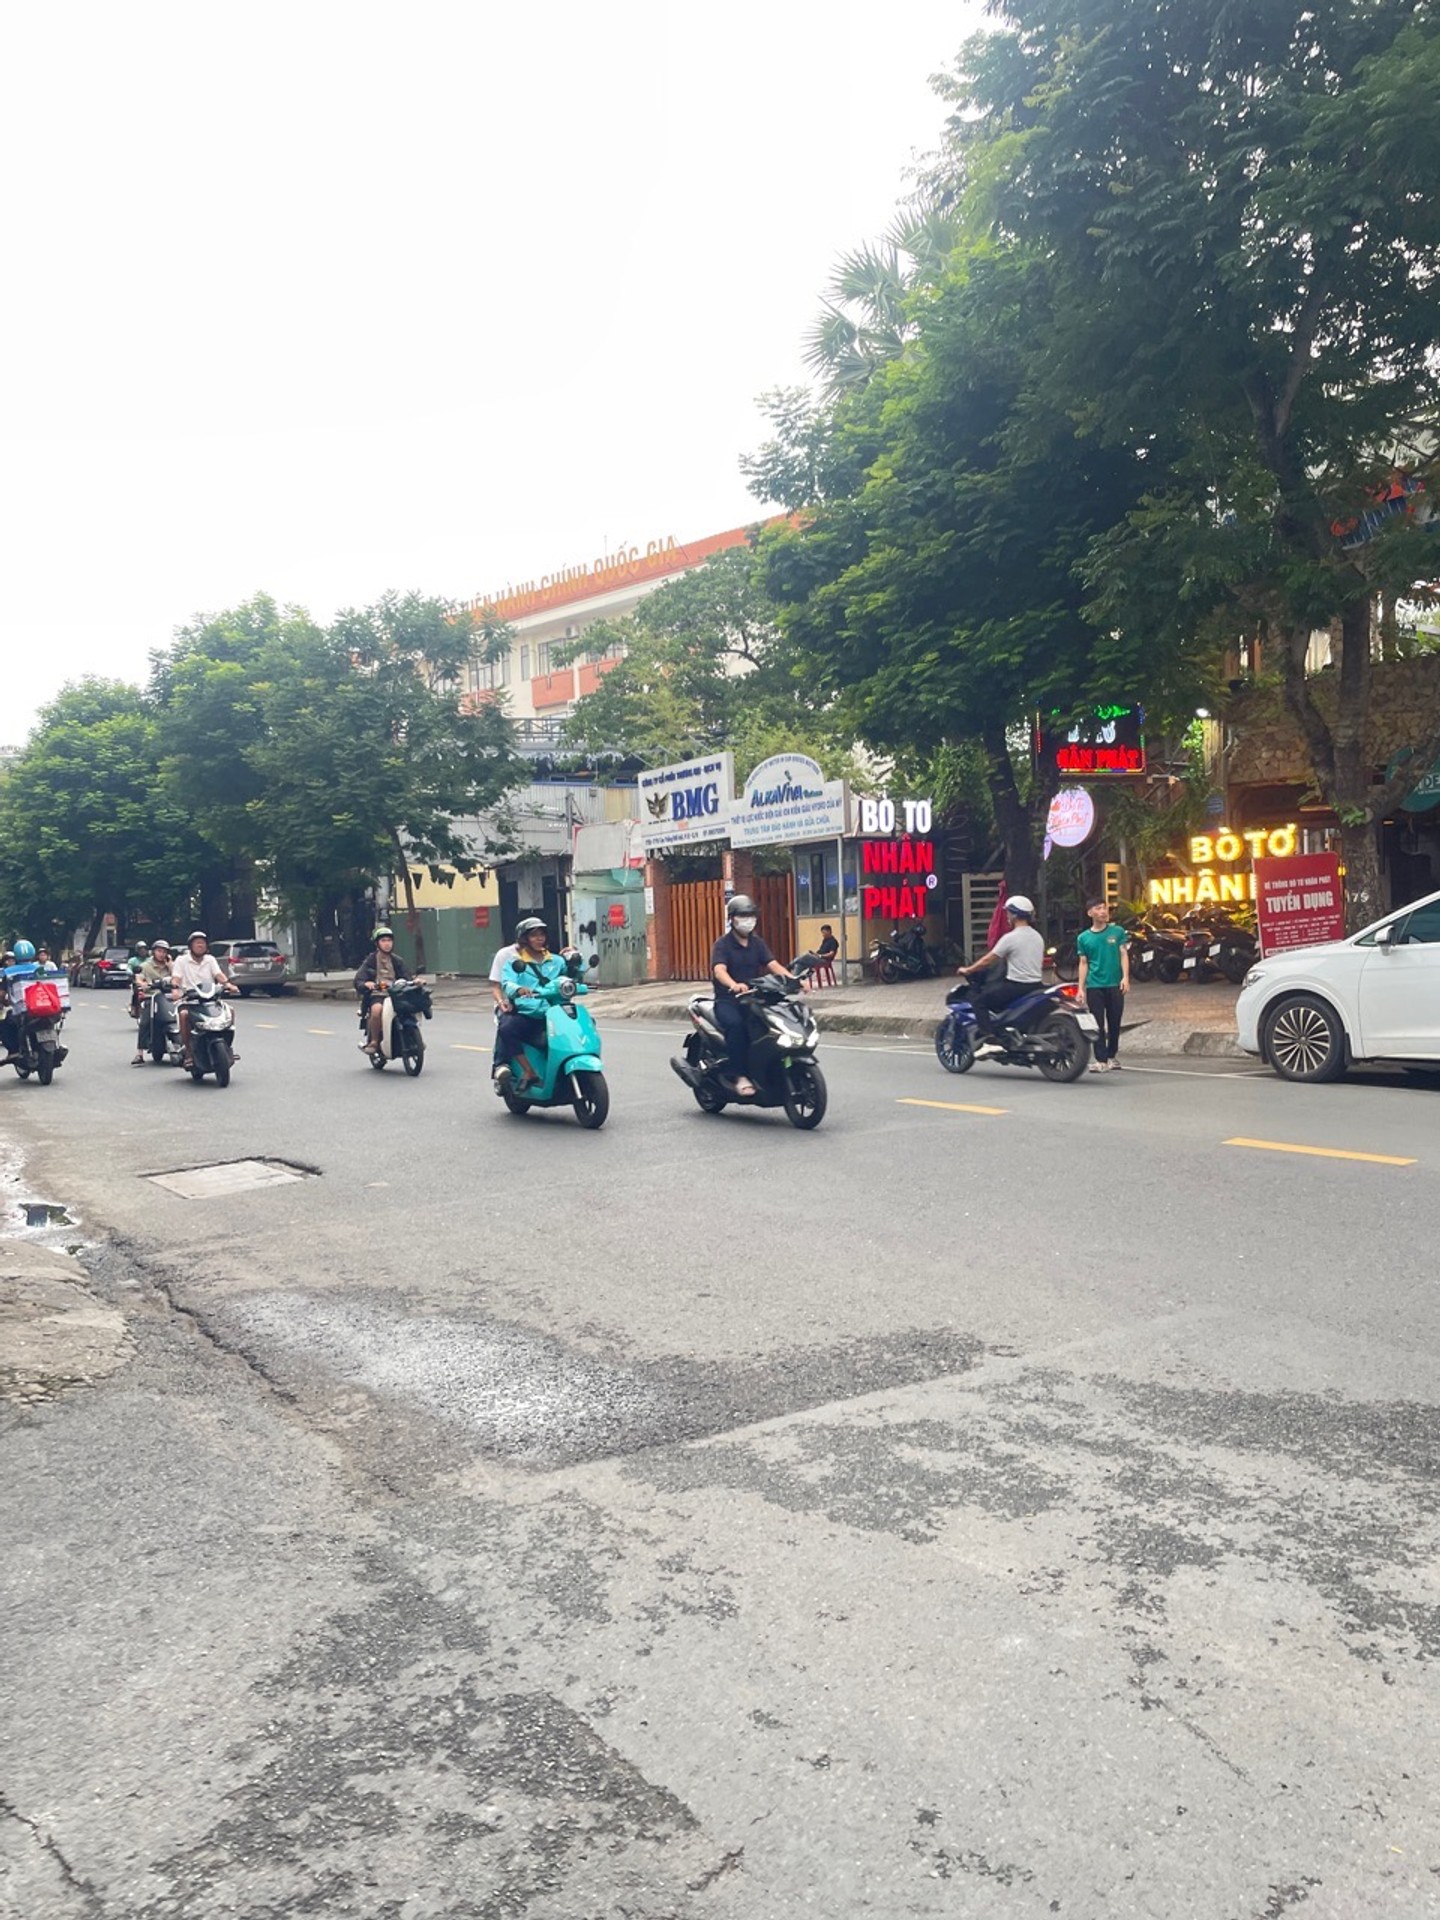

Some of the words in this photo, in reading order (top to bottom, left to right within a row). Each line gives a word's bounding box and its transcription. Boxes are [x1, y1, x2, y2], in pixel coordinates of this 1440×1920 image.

[496, 582, 536, 614] HÀNH
[541, 562, 588, 600] CHÍNH
[594, 541, 640, 584] QUỐC
[647, 535, 677, 565] GIA
[671, 782, 720, 822] BMG
[863, 832, 934, 873] NHÂN
[1191, 826, 1242, 864] BÒ
[1243, 823, 1297, 858] TƠ
[864, 878, 927, 920] PHÁT
[1150, 868, 1245, 904] NHÂN
[1265, 889, 1301, 913] TUYỂN
[1303, 891, 1334, 912] DỤNG
